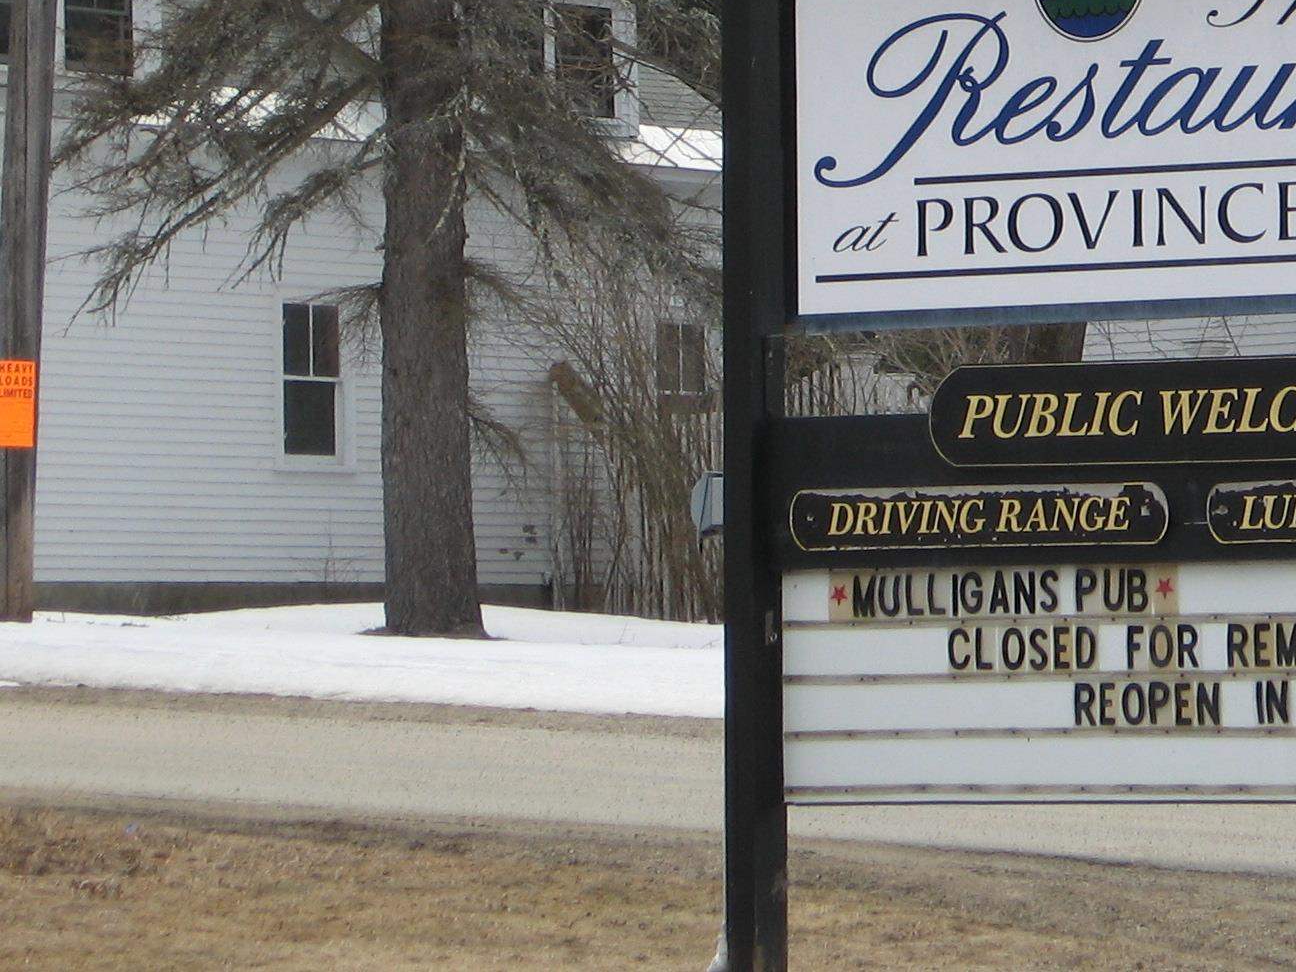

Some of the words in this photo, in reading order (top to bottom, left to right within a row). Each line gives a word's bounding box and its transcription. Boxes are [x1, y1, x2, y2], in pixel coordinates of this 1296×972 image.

[833, 212, 896, 253] at
[957, 391, 1143, 439] PUBLIC
[827, 497, 986, 536] DRIVING
[996, 495, 1131, 533] RANGE
[851, 570, 1059, 618] MULLIGANS
[1075, 568, 1150, 614] PUB
[947, 626, 1097, 672] CLOSED
[1127, 623, 1199, 669] FOR
[1074, 681, 1220, 727] REOPEN
[1256, 679, 1290, 725] IN
